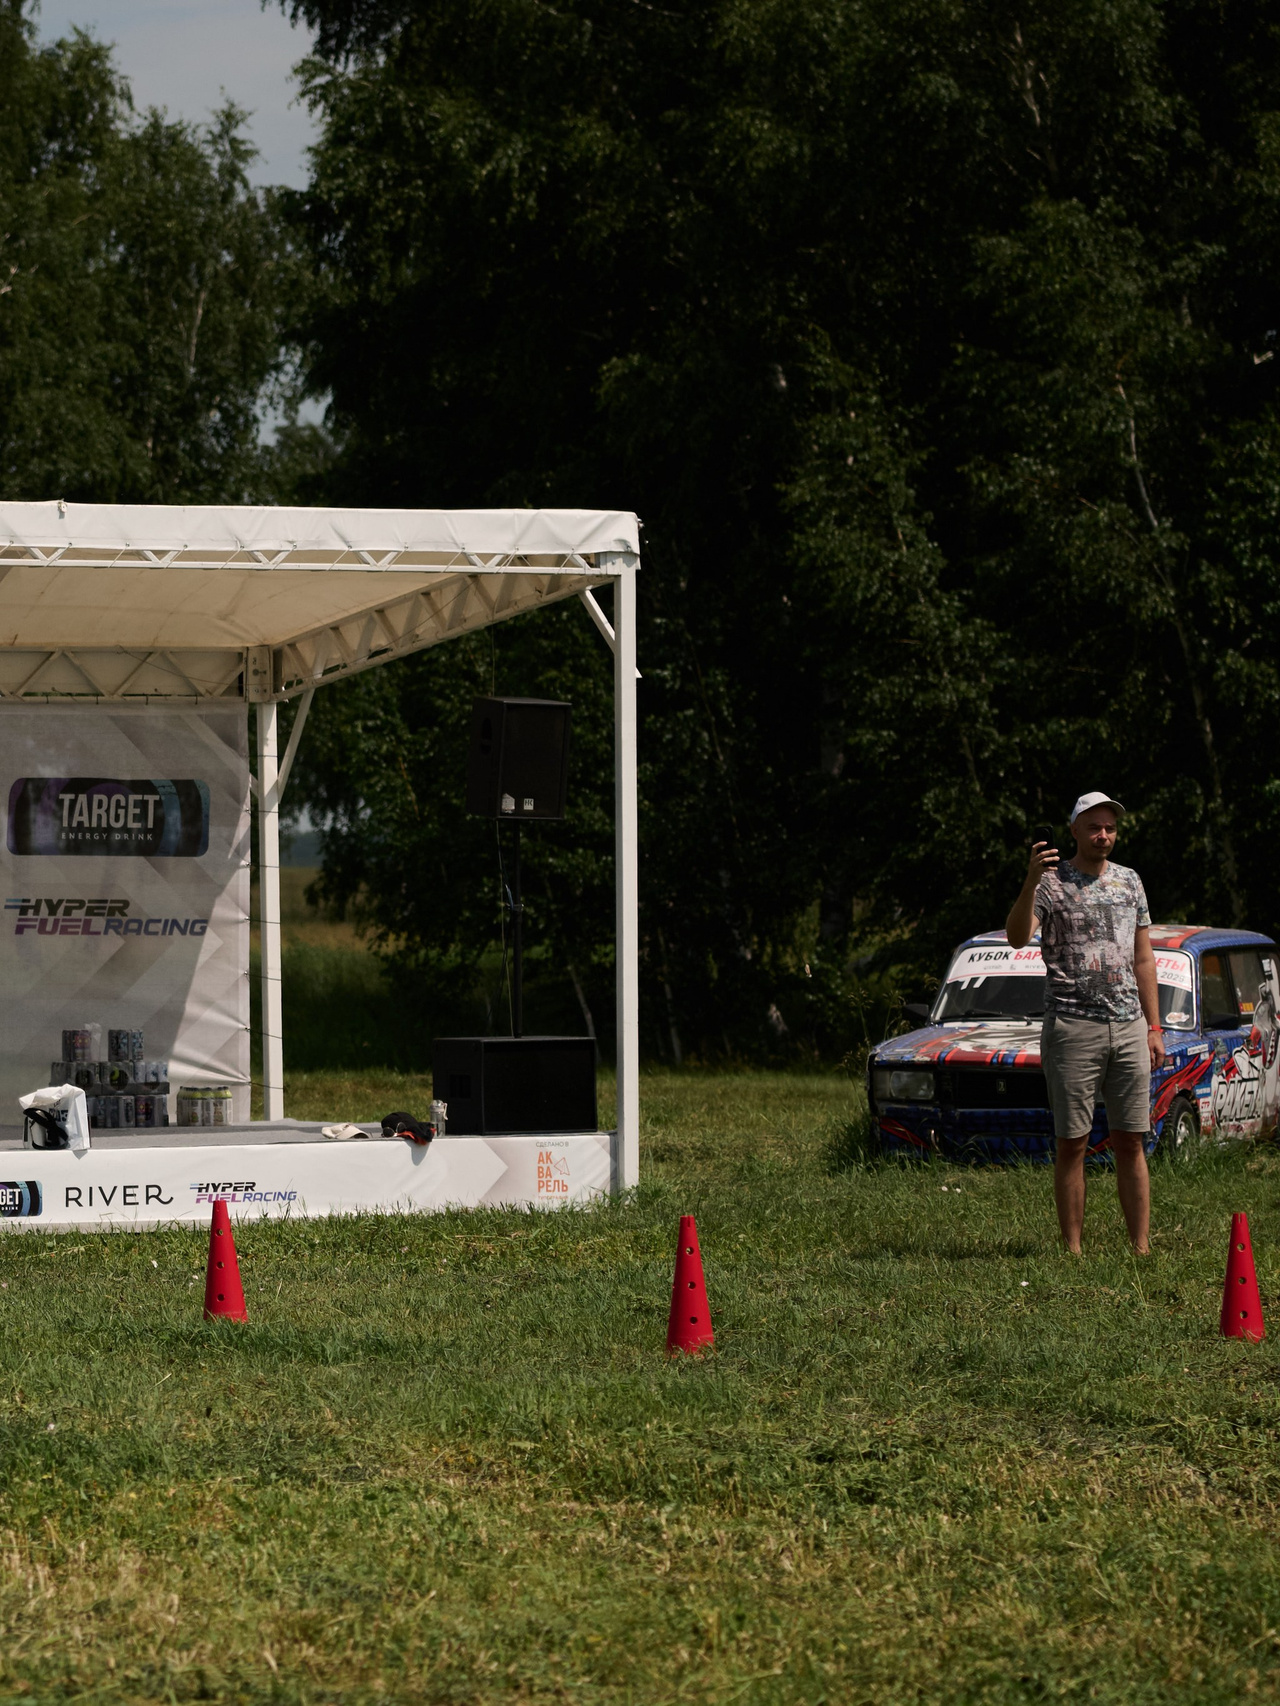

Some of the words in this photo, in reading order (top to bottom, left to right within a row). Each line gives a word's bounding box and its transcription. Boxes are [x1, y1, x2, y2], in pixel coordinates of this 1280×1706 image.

[59, 793, 160, 829] TARGET
[61, 832, 108, 840] ENERGY
[115, 833, 153, 841] DRINK
[19, 898, 131, 918] HYPER
[968, 951, 1013, 963] КУБОК
[198, 1182, 256, 1193] HYPER
[537, 1180, 569, 1193] РЕЛЬ
[65, 1184, 174, 1208] RIVER
